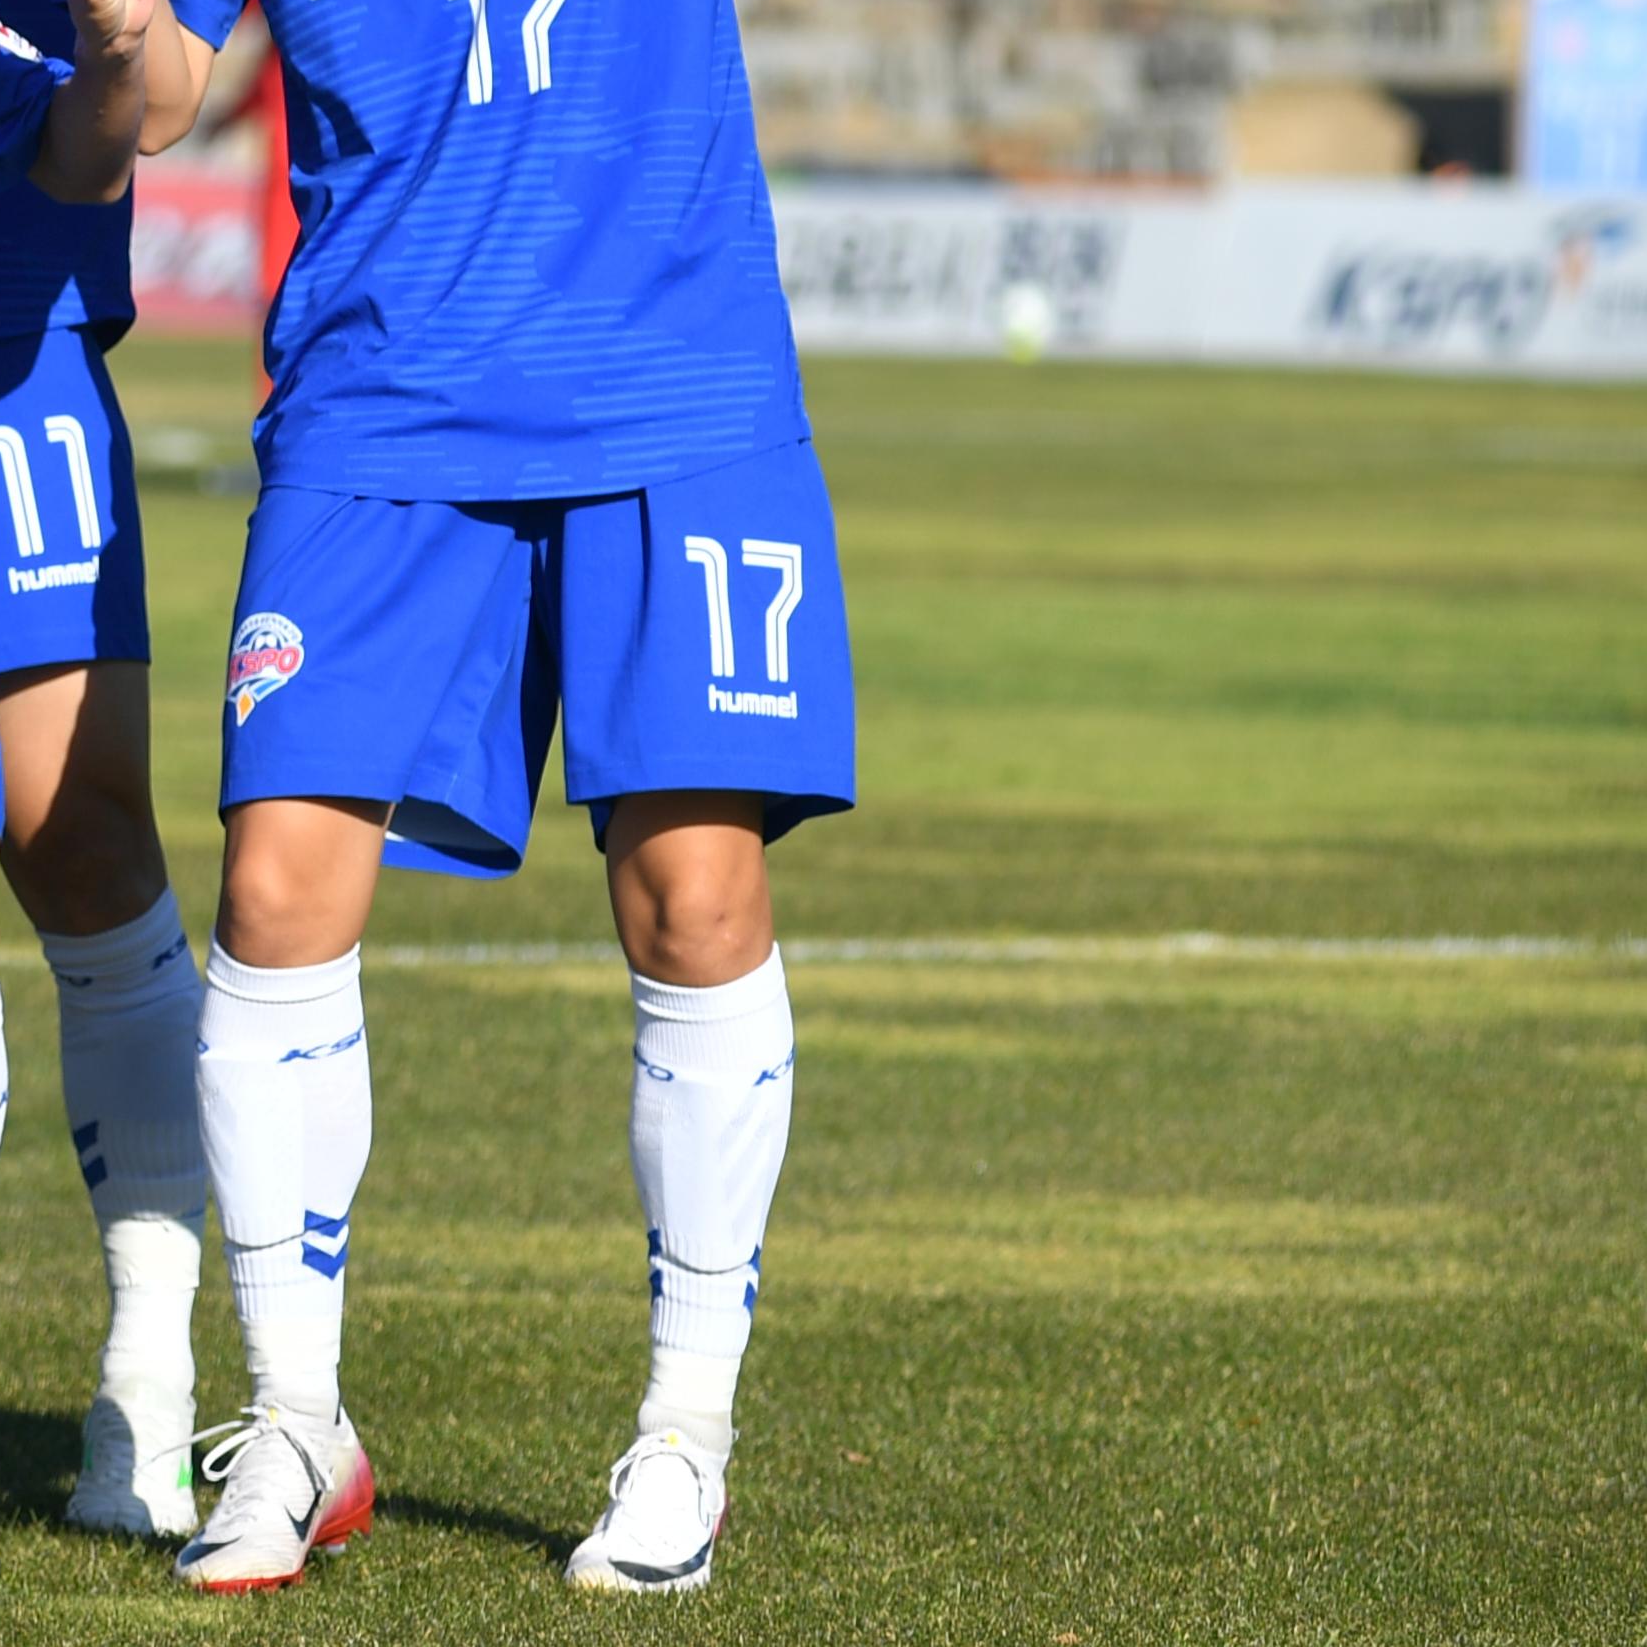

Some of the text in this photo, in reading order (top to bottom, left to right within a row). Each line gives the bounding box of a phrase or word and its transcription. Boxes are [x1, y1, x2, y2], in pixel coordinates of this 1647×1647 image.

[8, 556, 101, 595] hummel
[684, 535, 804, 683] 17
[708, 683, 798, 720] hummel
